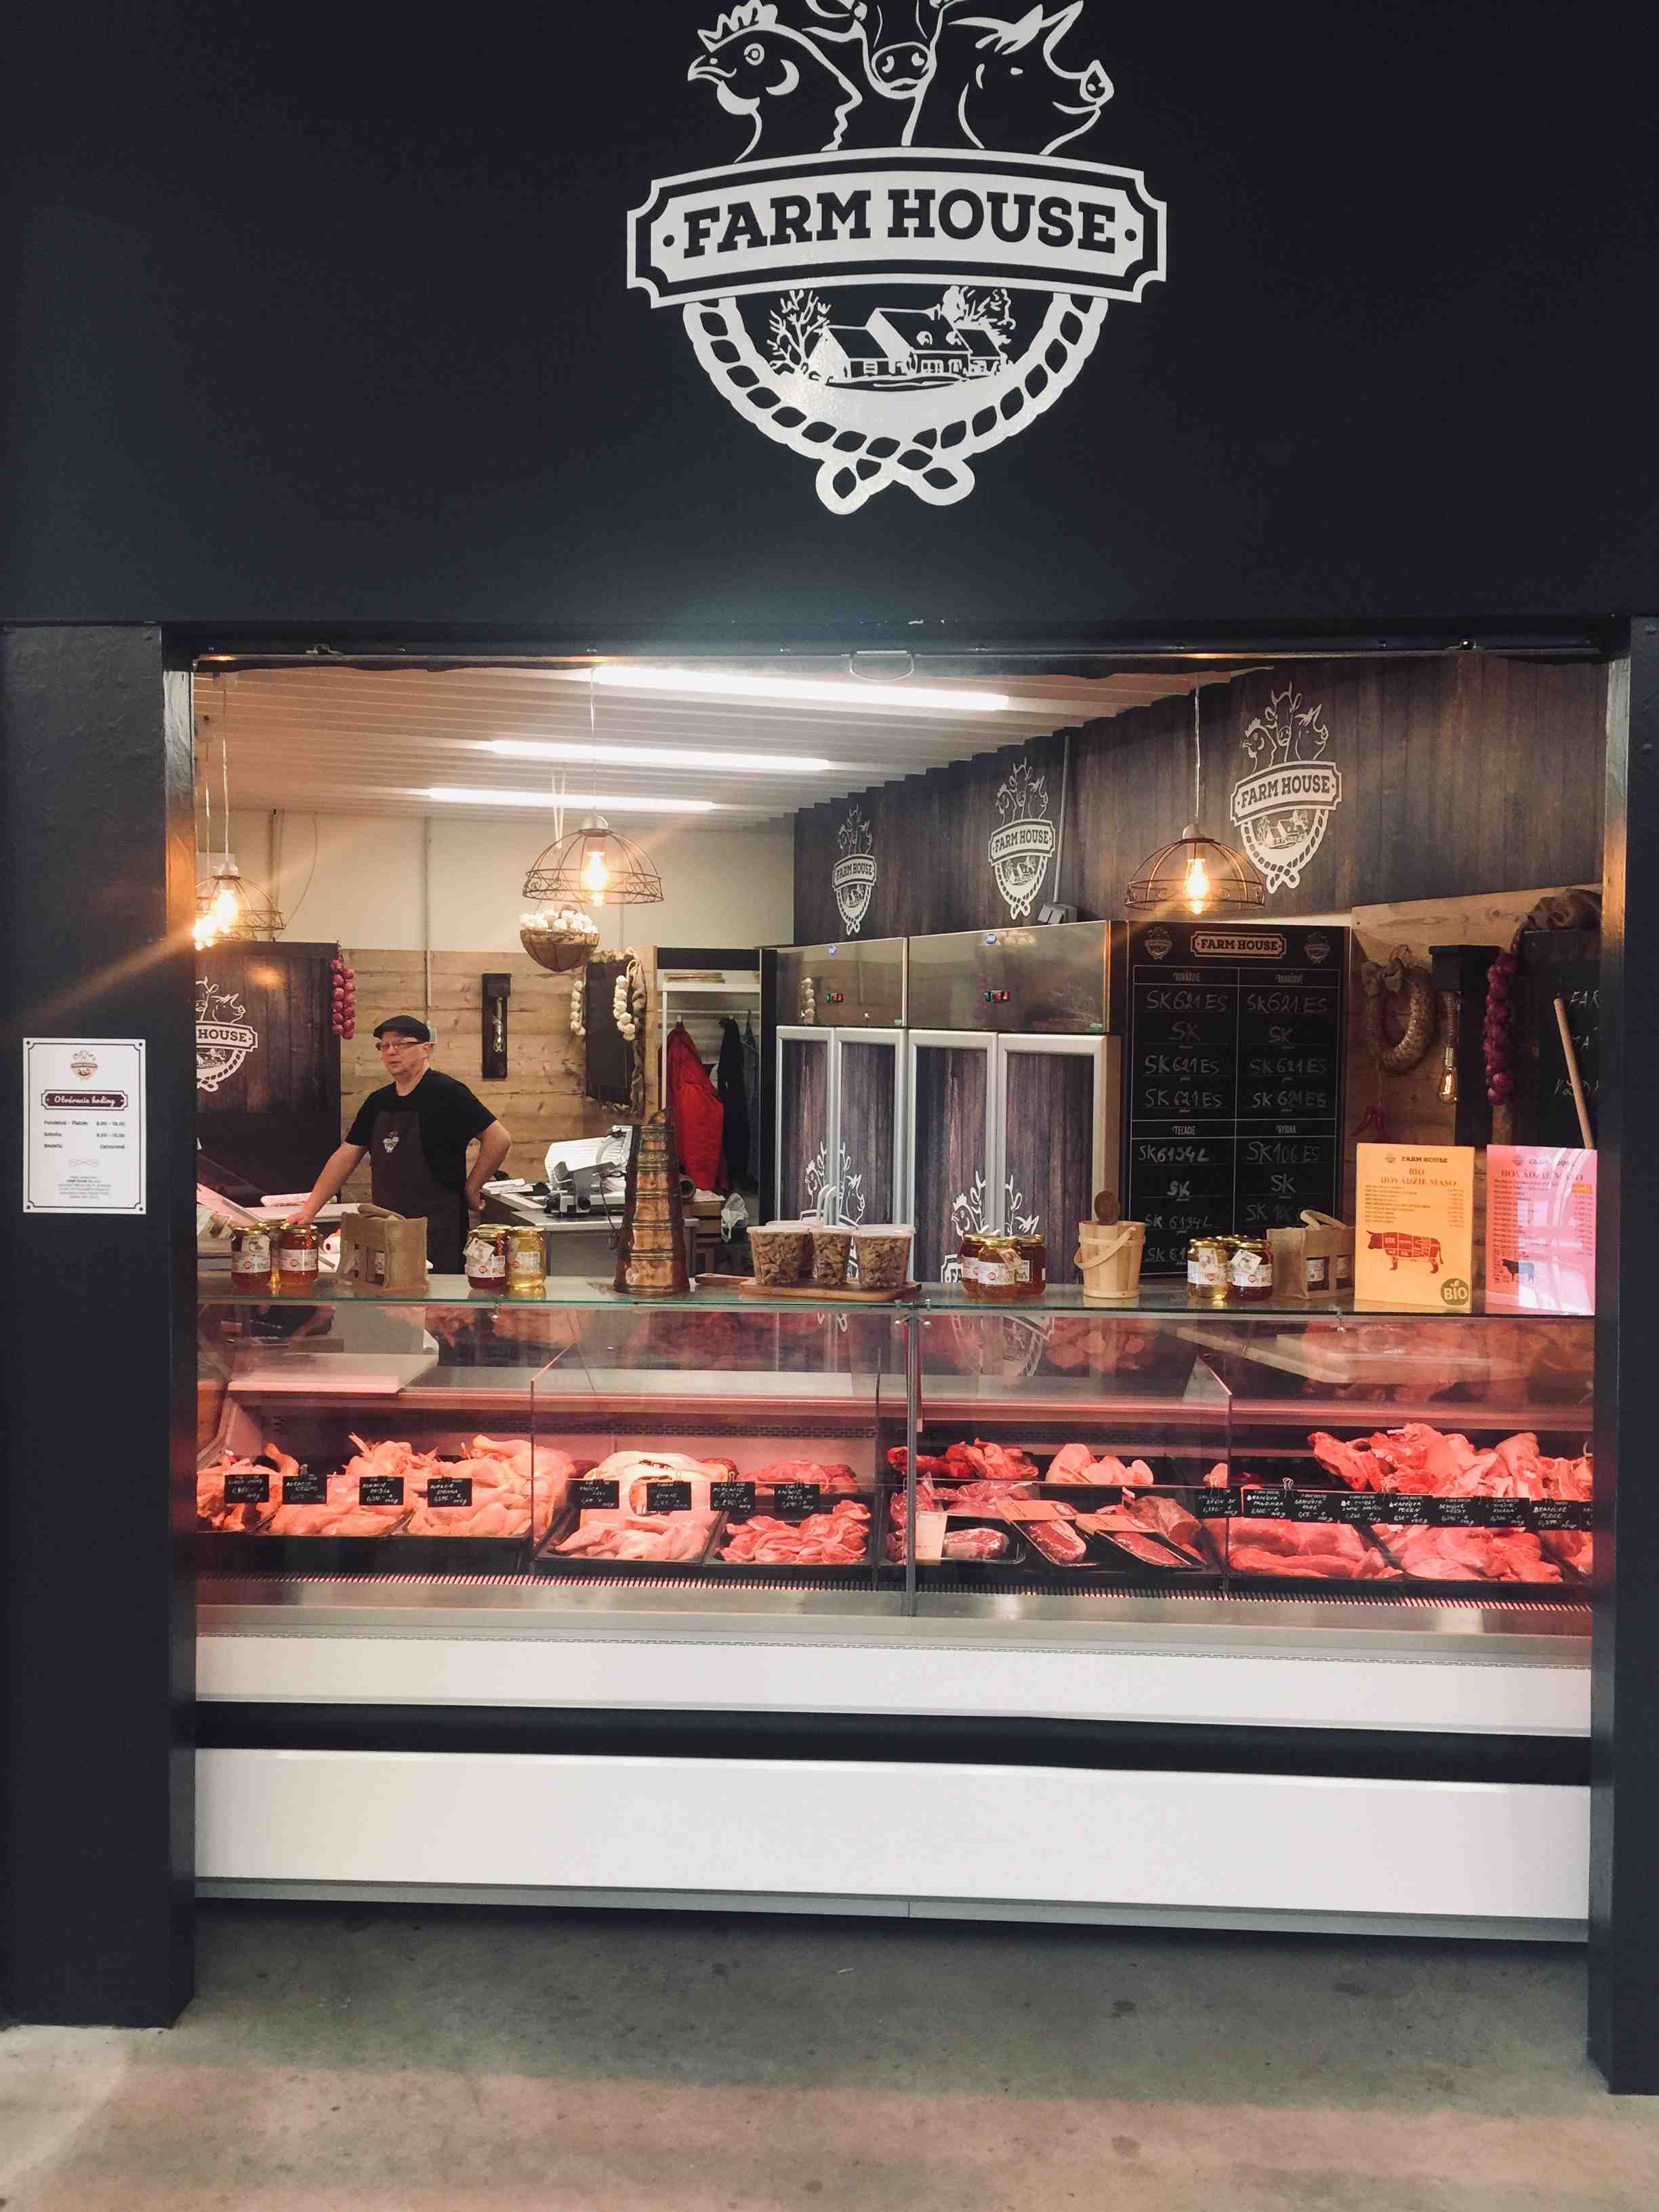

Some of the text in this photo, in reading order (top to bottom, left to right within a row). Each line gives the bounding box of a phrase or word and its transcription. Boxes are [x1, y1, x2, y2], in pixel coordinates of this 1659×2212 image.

[683, 188, 1116, 259] FARM HOUSE
[1241, 775, 1330, 809] FARM HOUSE
[994, 829, 1049, 853] FARM HOUSE
[836, 864, 852, 881] FARM
[1200, 939, 1279, 951] FARM HOUSE
[197, 1029, 247, 1042] HOUSE
[1443, 1287, 1468, 1300] BIO
